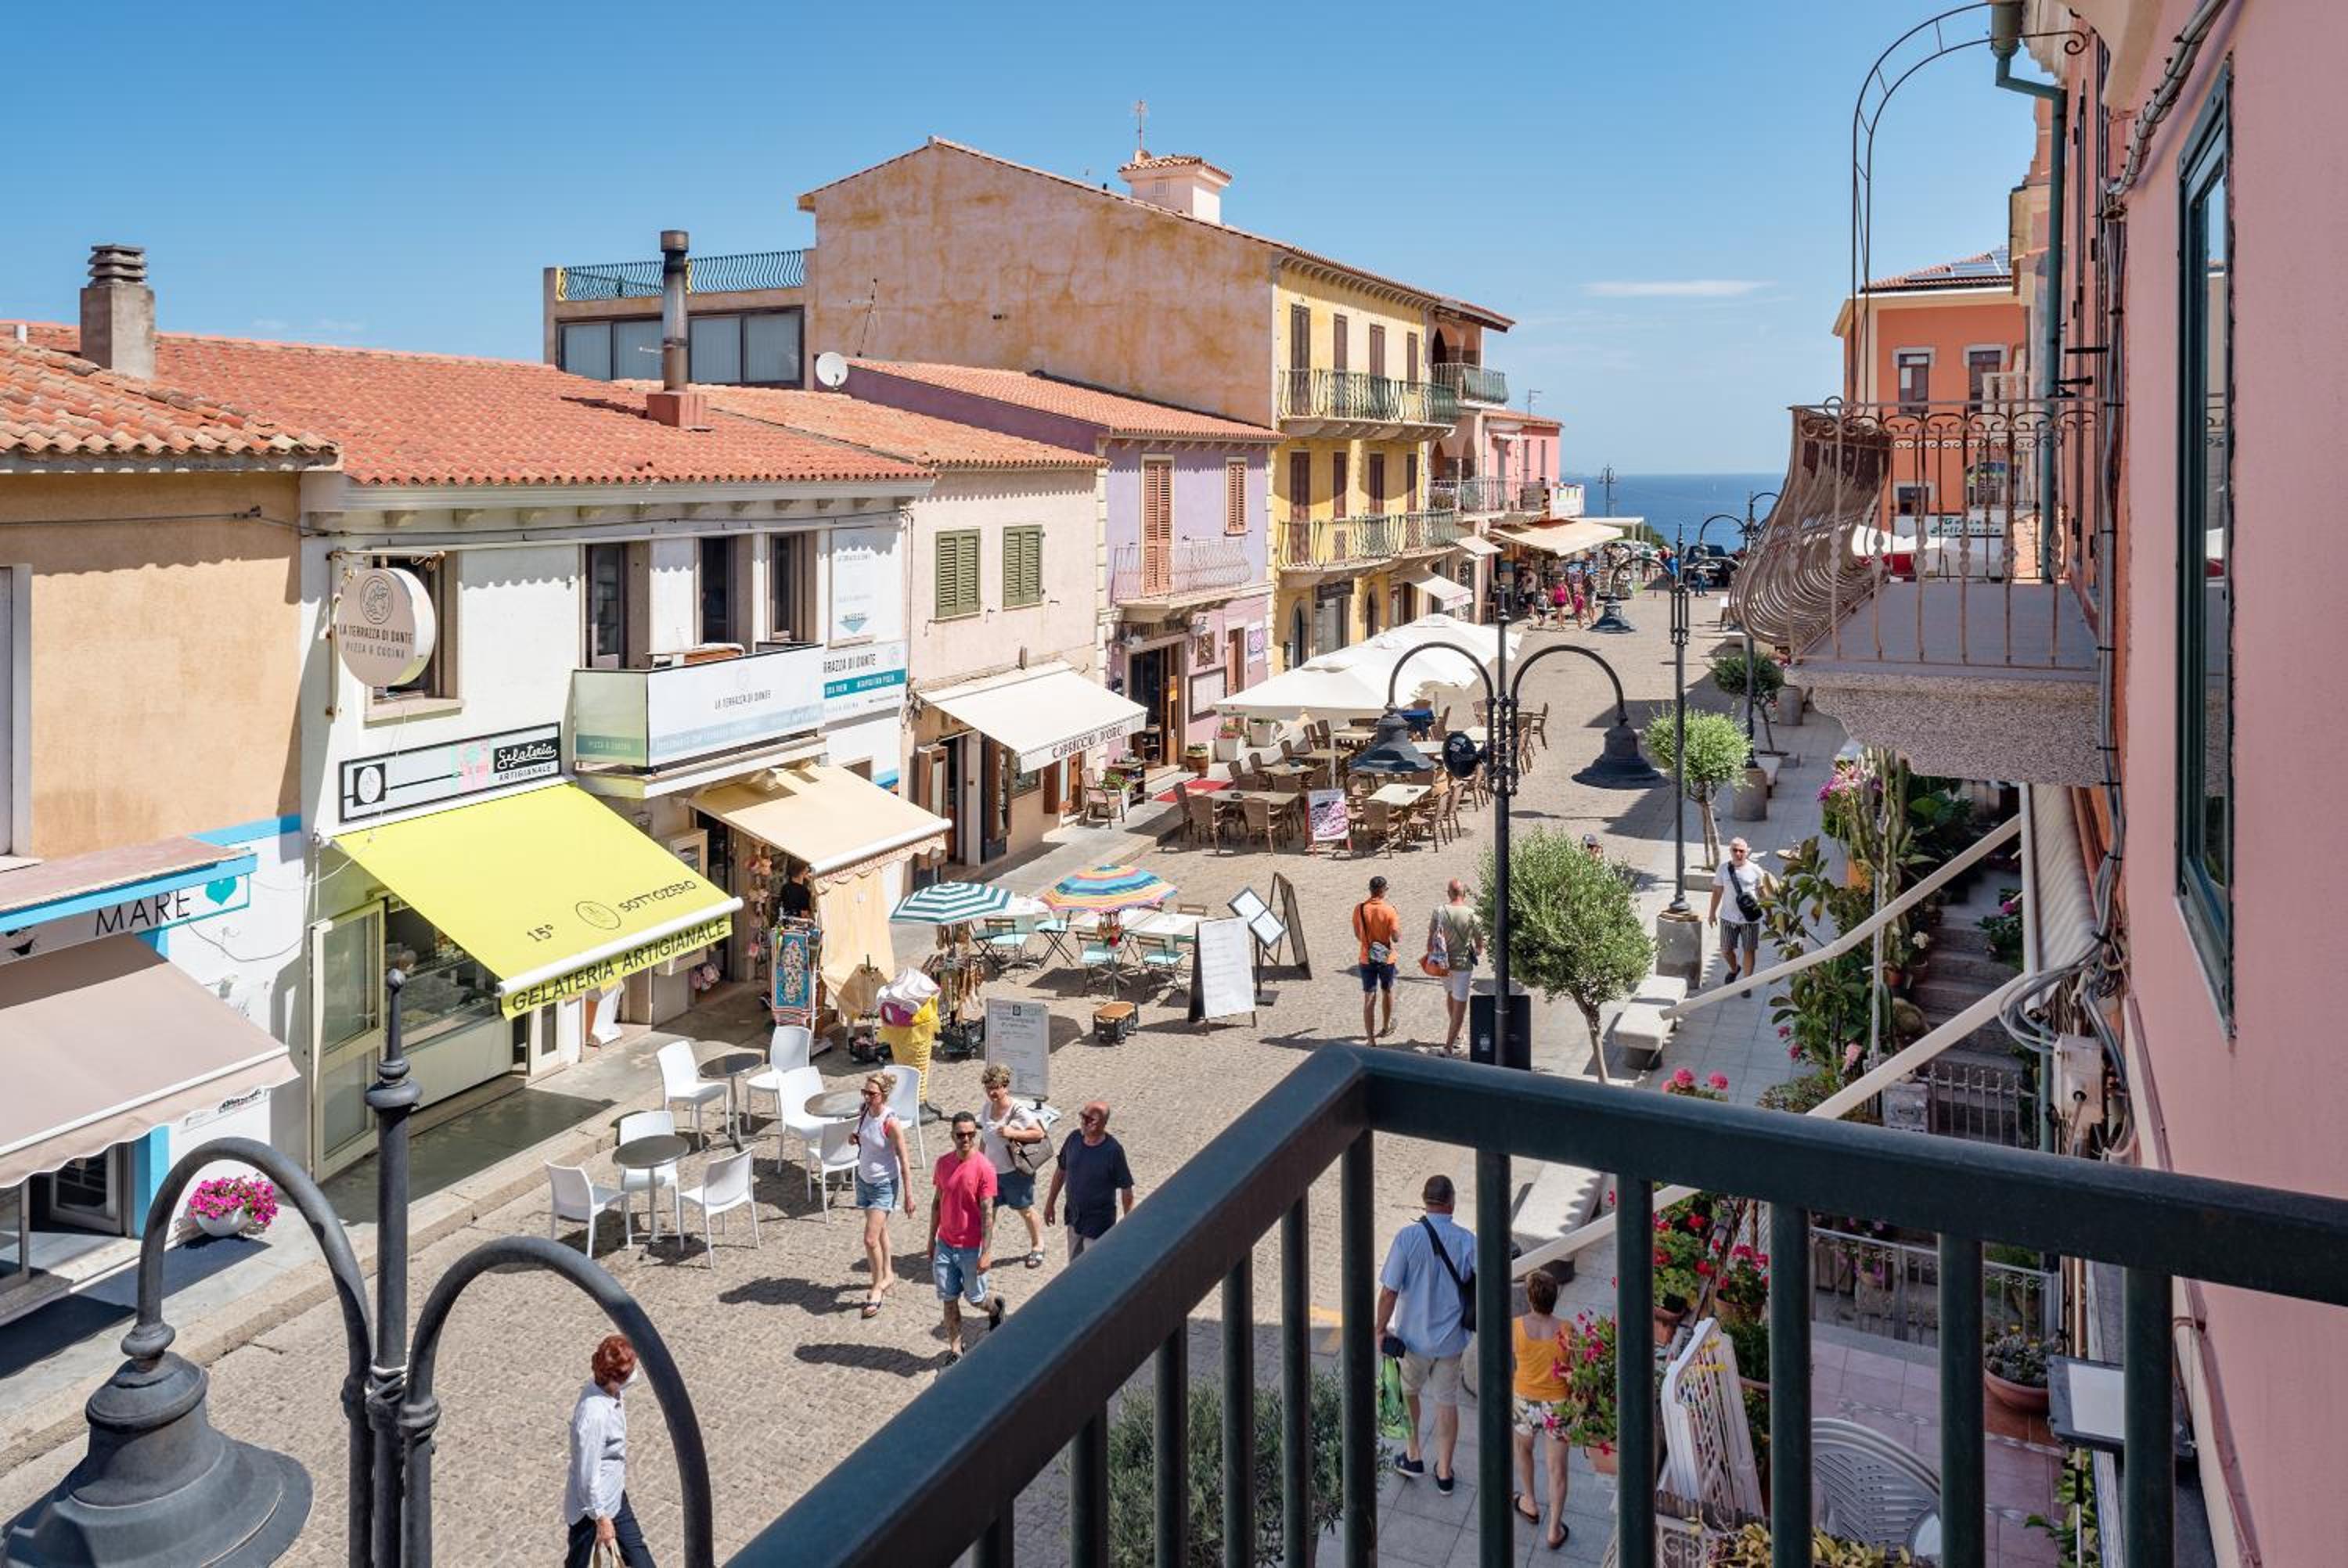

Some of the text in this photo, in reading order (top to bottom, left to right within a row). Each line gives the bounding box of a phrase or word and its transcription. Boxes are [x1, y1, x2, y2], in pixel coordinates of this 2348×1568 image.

[349, 625, 380, 639] TERRAZZA
[382, 629, 389, 641] DI
[391, 630, 413, 645] DANTE
[345, 641, 366, 653] PIZZA
[376, 646, 405, 659] CUCINA
[496, 742, 556, 770] Gelateria
[499, 764, 552, 782] ARTIGIANALE
[618, 879, 697, 912] SOTTOZERO
[95, 890, 191, 937] MARE
[512, 917, 727, 1012] GELATERIA ARTIGIANALE
